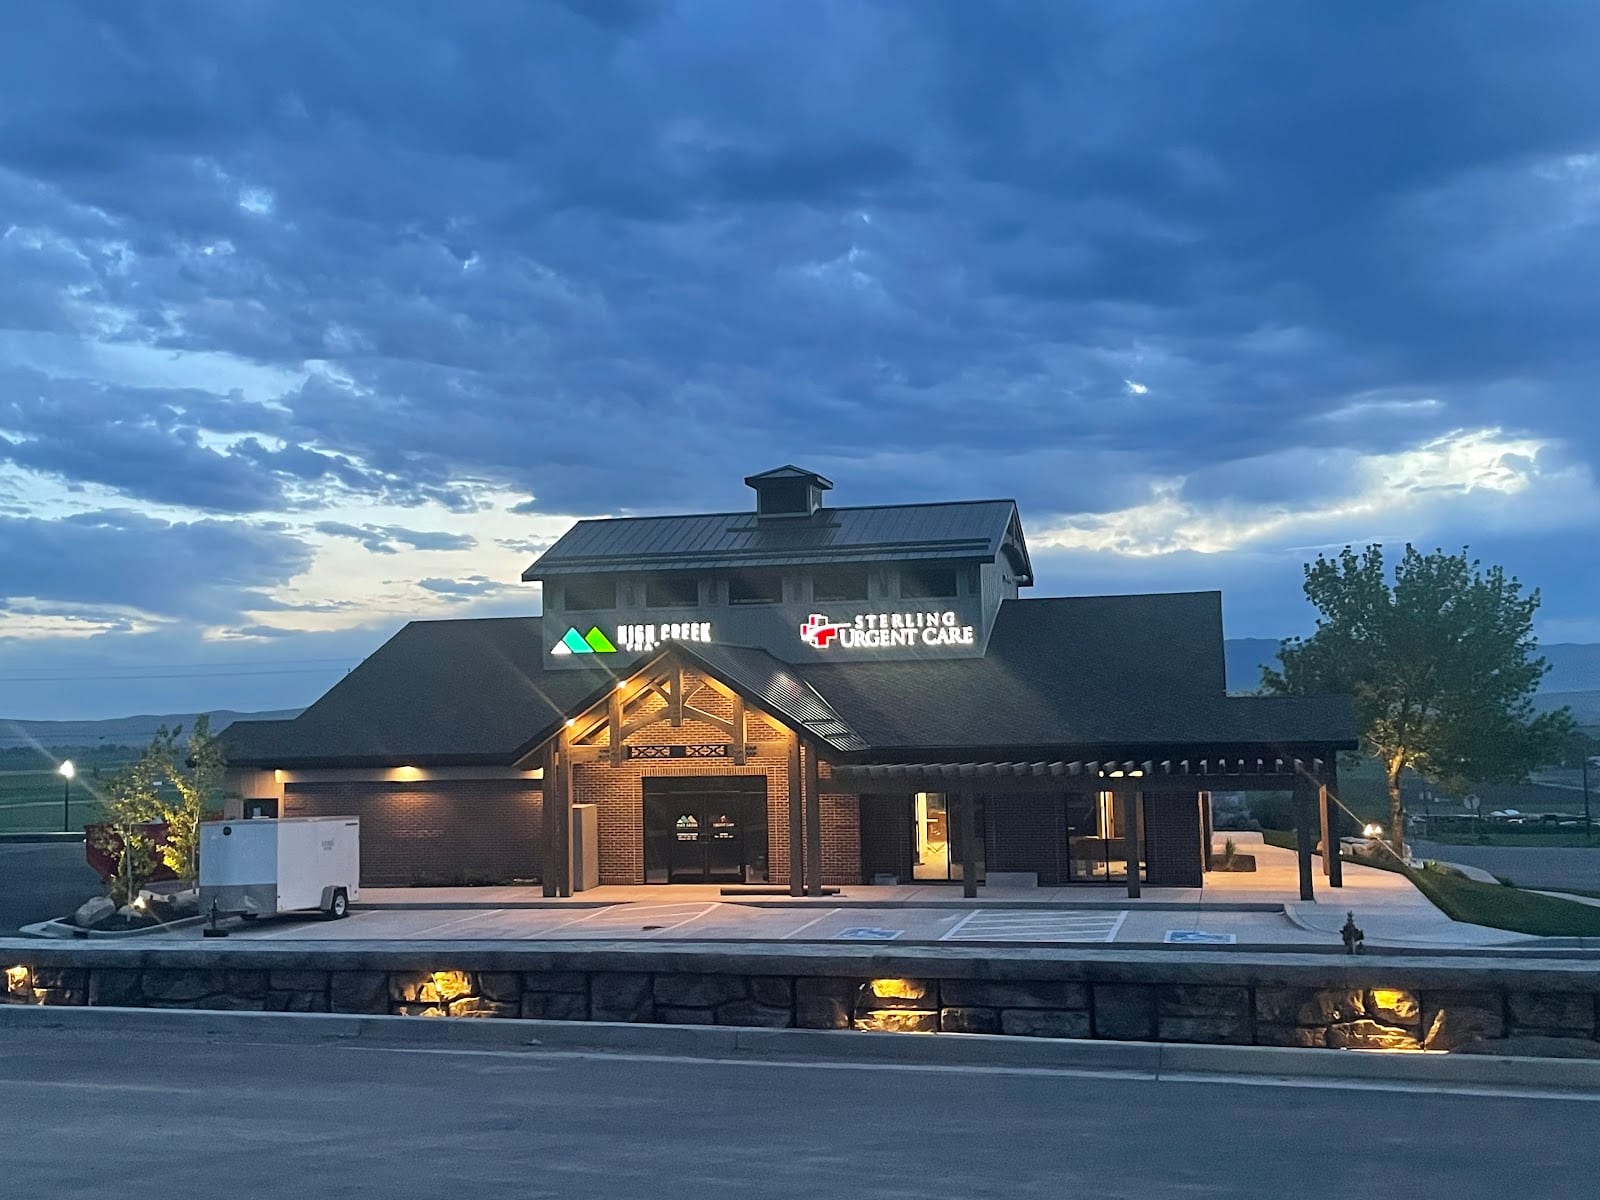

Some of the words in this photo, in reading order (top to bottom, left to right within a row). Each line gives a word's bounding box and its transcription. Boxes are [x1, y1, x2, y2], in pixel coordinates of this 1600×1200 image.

[854, 611, 955, 629] STERLING
[617, 624, 655, 644] HIGH
[660, 622, 711, 642] CREEK
[839, 628, 918, 648] URGENT
[922, 625, 974, 646] CARE
